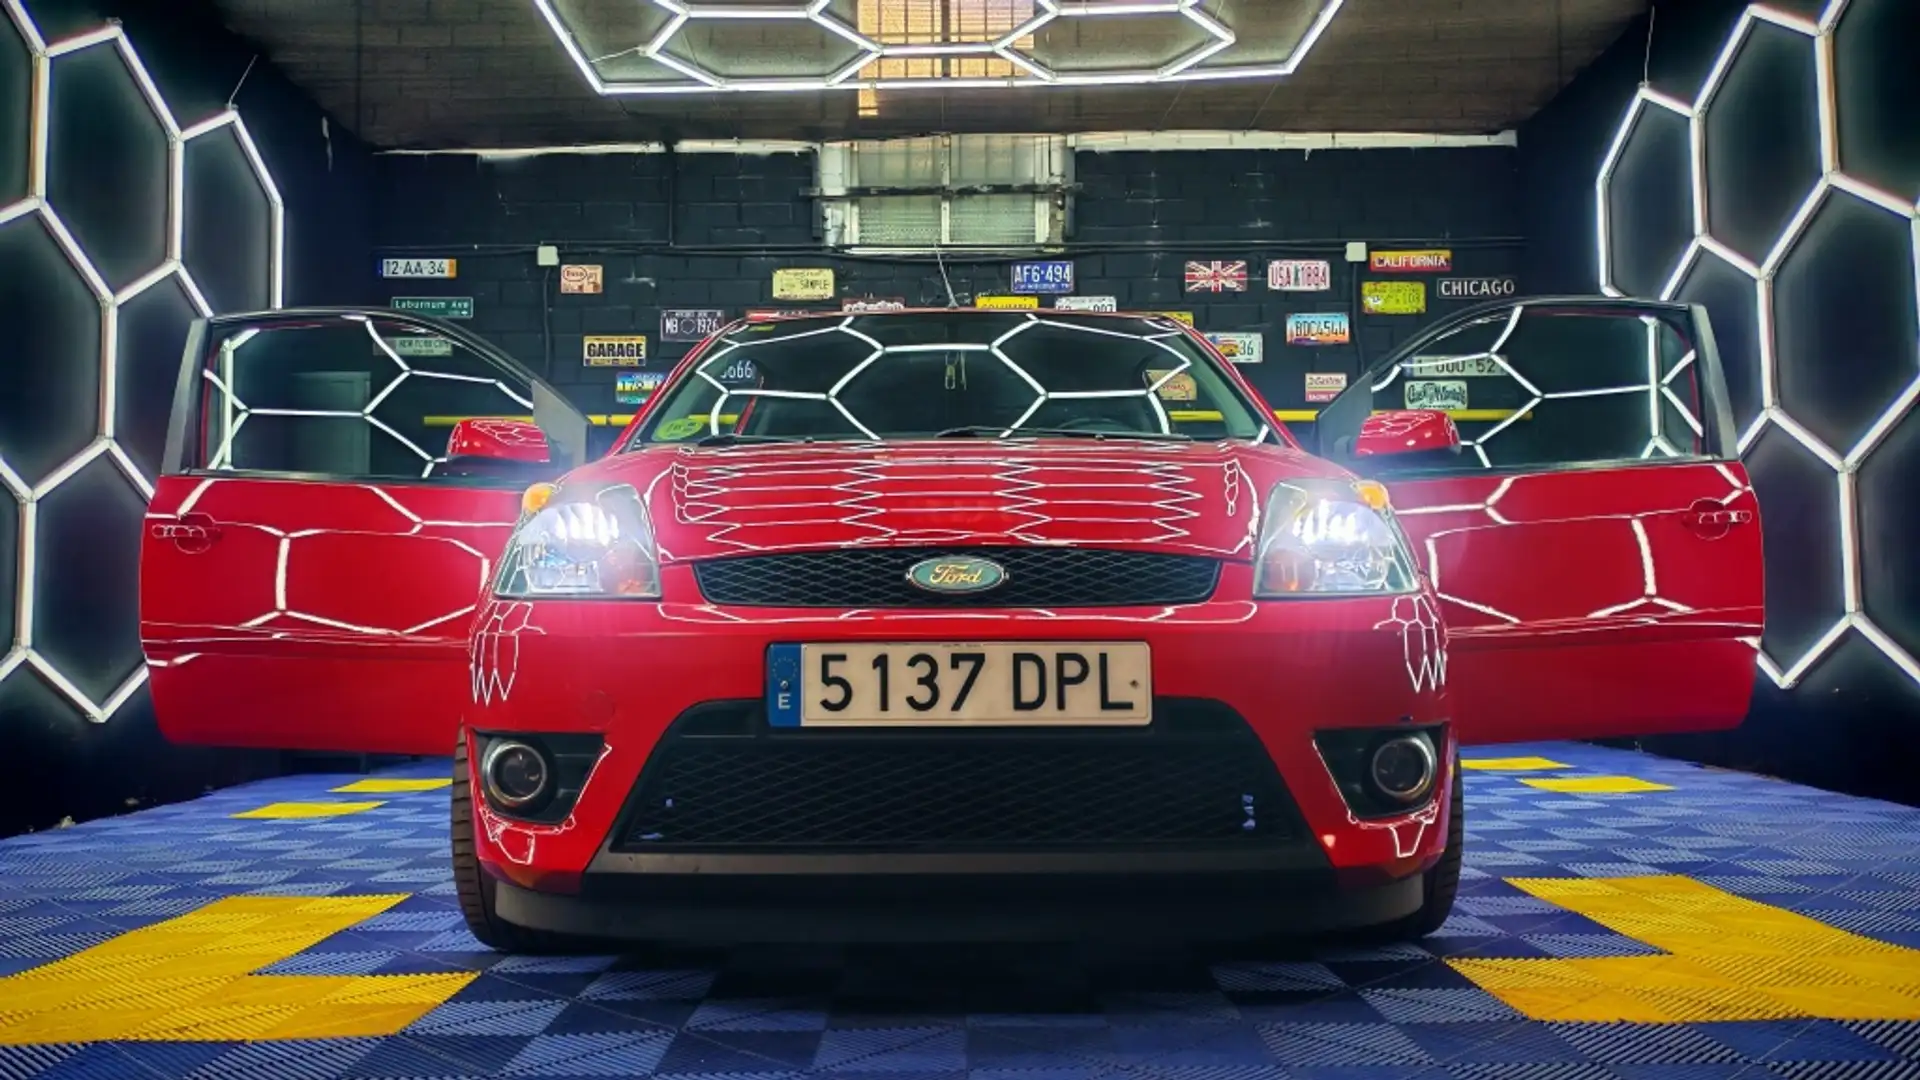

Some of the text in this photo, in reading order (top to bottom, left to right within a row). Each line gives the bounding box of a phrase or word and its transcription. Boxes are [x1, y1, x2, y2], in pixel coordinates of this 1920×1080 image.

[1375, 256, 1447, 268] CALIFORNIA
[1271, 266, 1291, 286] USA
[1441, 280, 1515, 296] CHICAGO
[587, 343, 643, 357] GARAGE
[930, 564, 983, 584] Ford
[820, 652, 1134, 712] 5137 DPL
[778, 693, 791, 710] E
